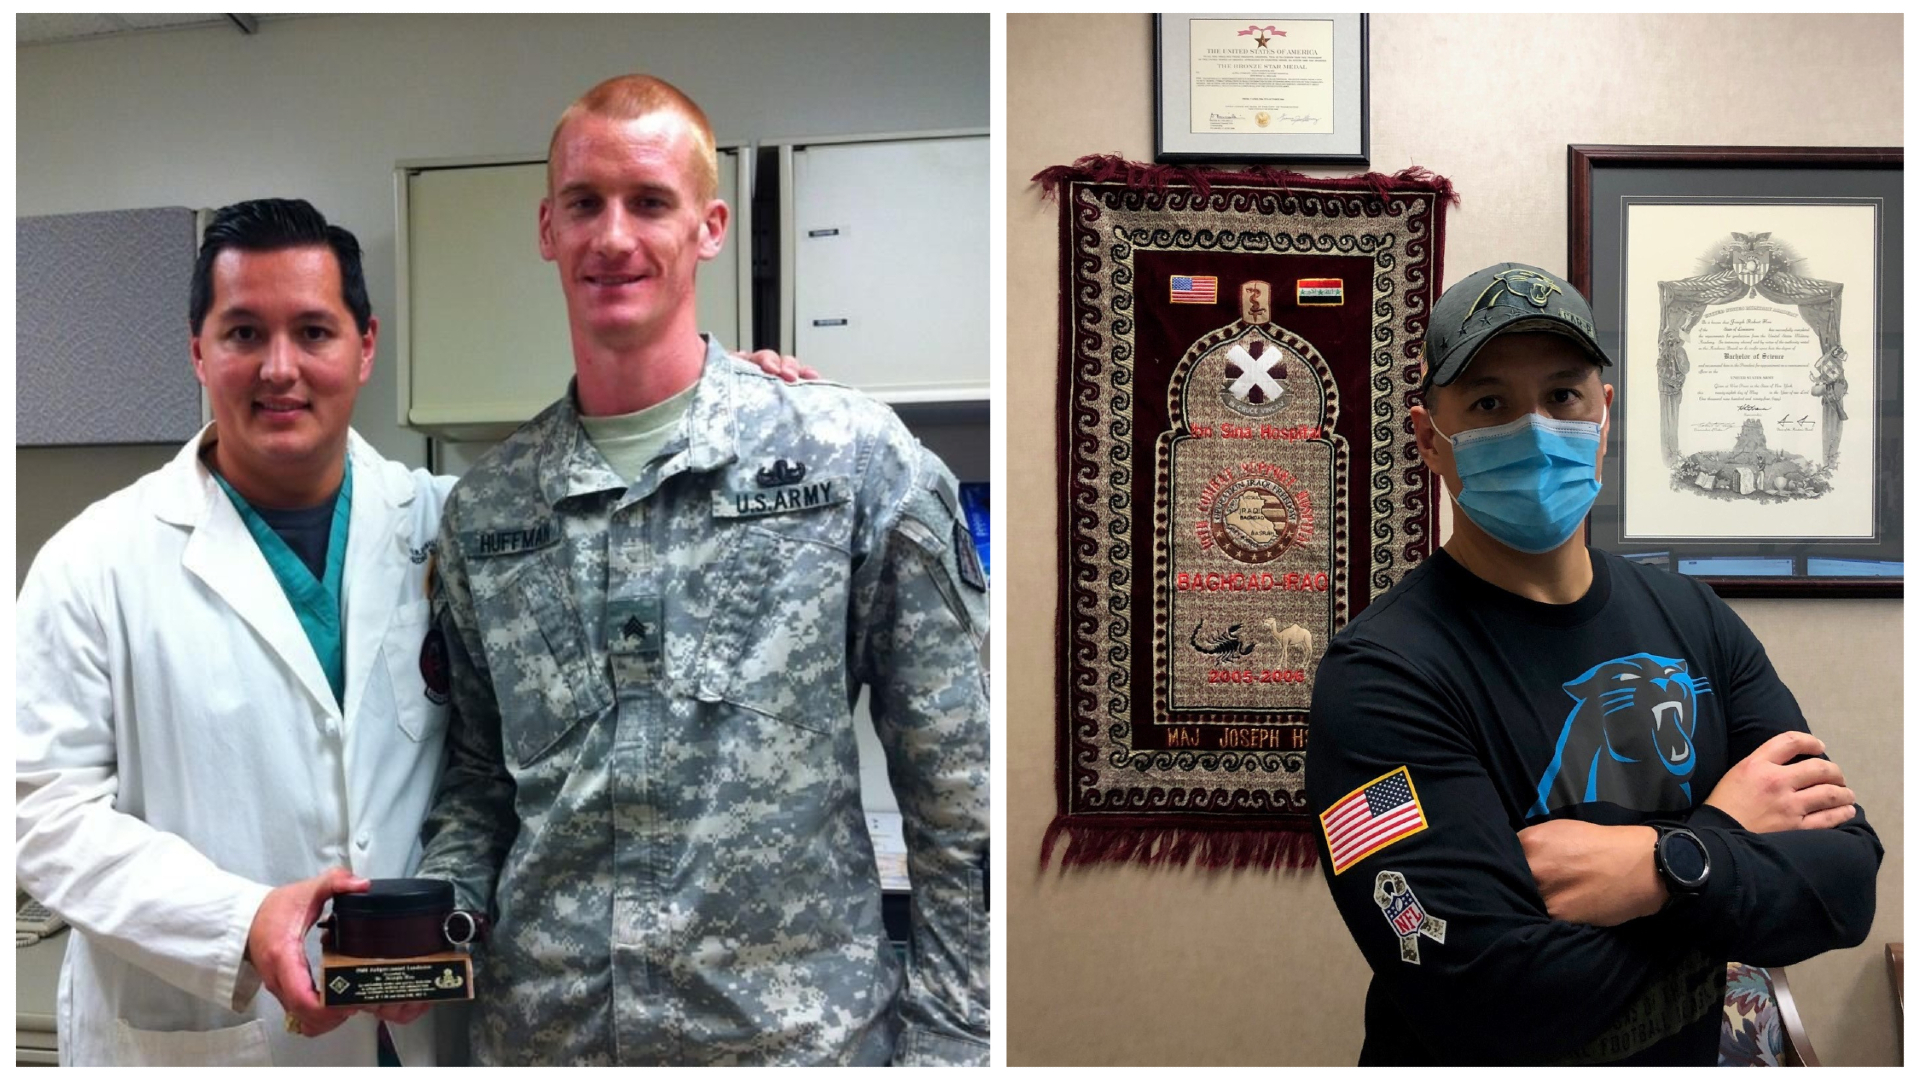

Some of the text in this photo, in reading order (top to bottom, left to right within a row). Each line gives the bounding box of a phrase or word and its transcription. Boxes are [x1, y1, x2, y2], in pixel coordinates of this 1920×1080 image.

[1221, 423, 1252, 439] Sina
[1261, 424, 1322, 443] Hospital
[480, 522, 550, 553] HUFFMAN
[1208, 669, 1305, 684] 2005-2006
[1168, 728, 1200, 747] MAJ
[1220, 728, 1279, 748] JOSEPH
[1394, 906, 1423, 934] NFL
